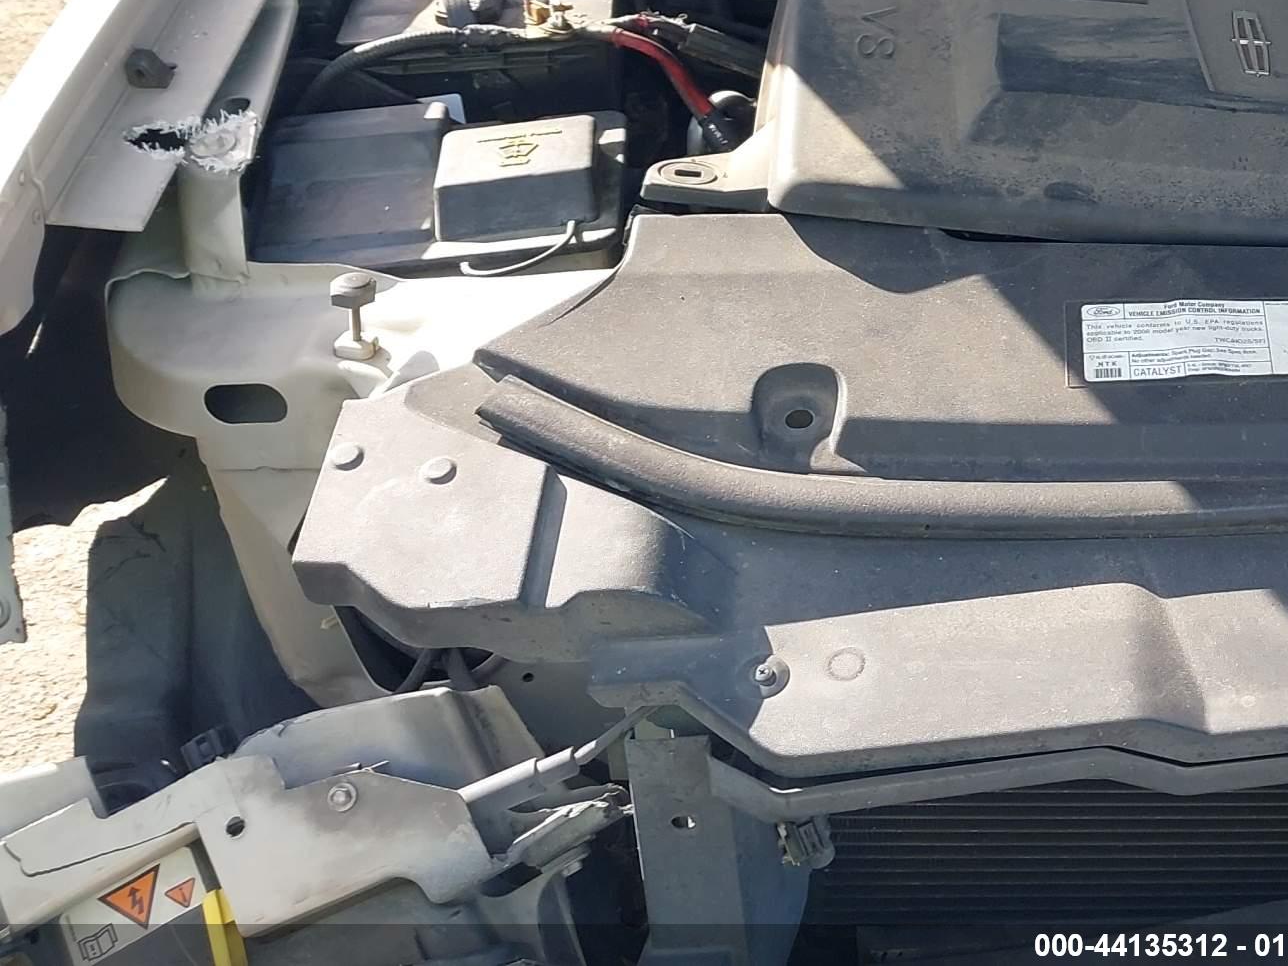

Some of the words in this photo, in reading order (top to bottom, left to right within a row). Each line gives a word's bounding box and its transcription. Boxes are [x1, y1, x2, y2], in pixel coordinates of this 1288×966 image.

[856, 6, 898, 60] V8
[1156, 307, 1187, 316] EMISSION
[1218, 307, 1261, 315] INFORMATION
[1133, 365, 1182, 377] CATALYST
